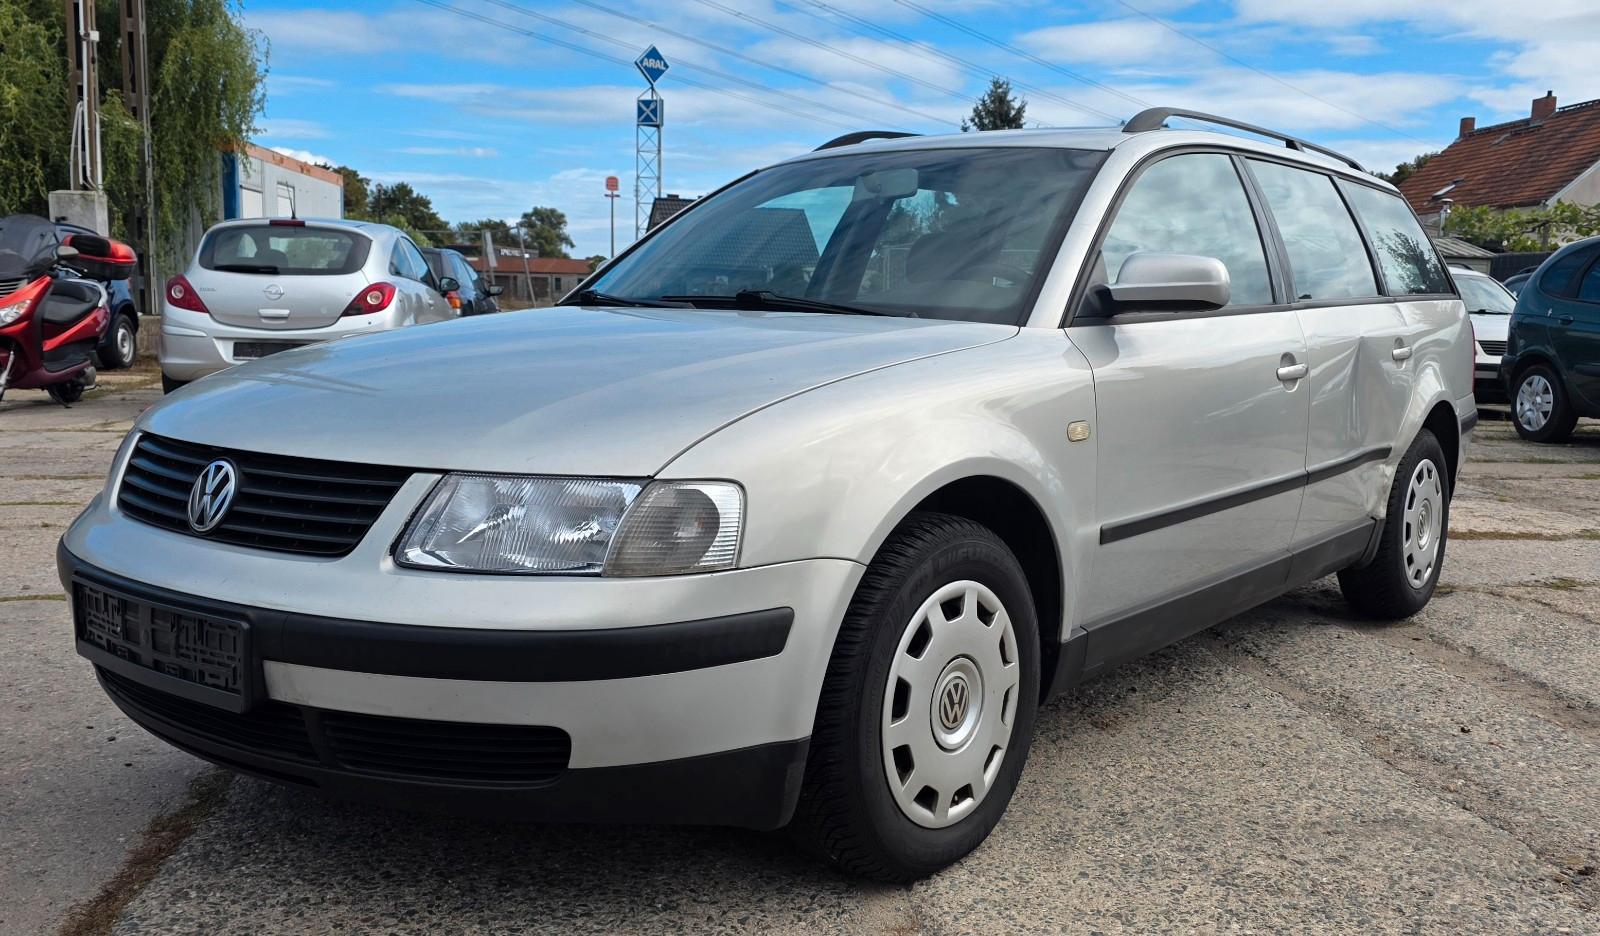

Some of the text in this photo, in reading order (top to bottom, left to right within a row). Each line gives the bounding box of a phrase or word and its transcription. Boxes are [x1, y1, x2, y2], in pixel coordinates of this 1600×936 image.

[642, 57, 666, 70] ARAL
[189, 461, 235, 531] VW
[941, 678, 968, 728] VW
